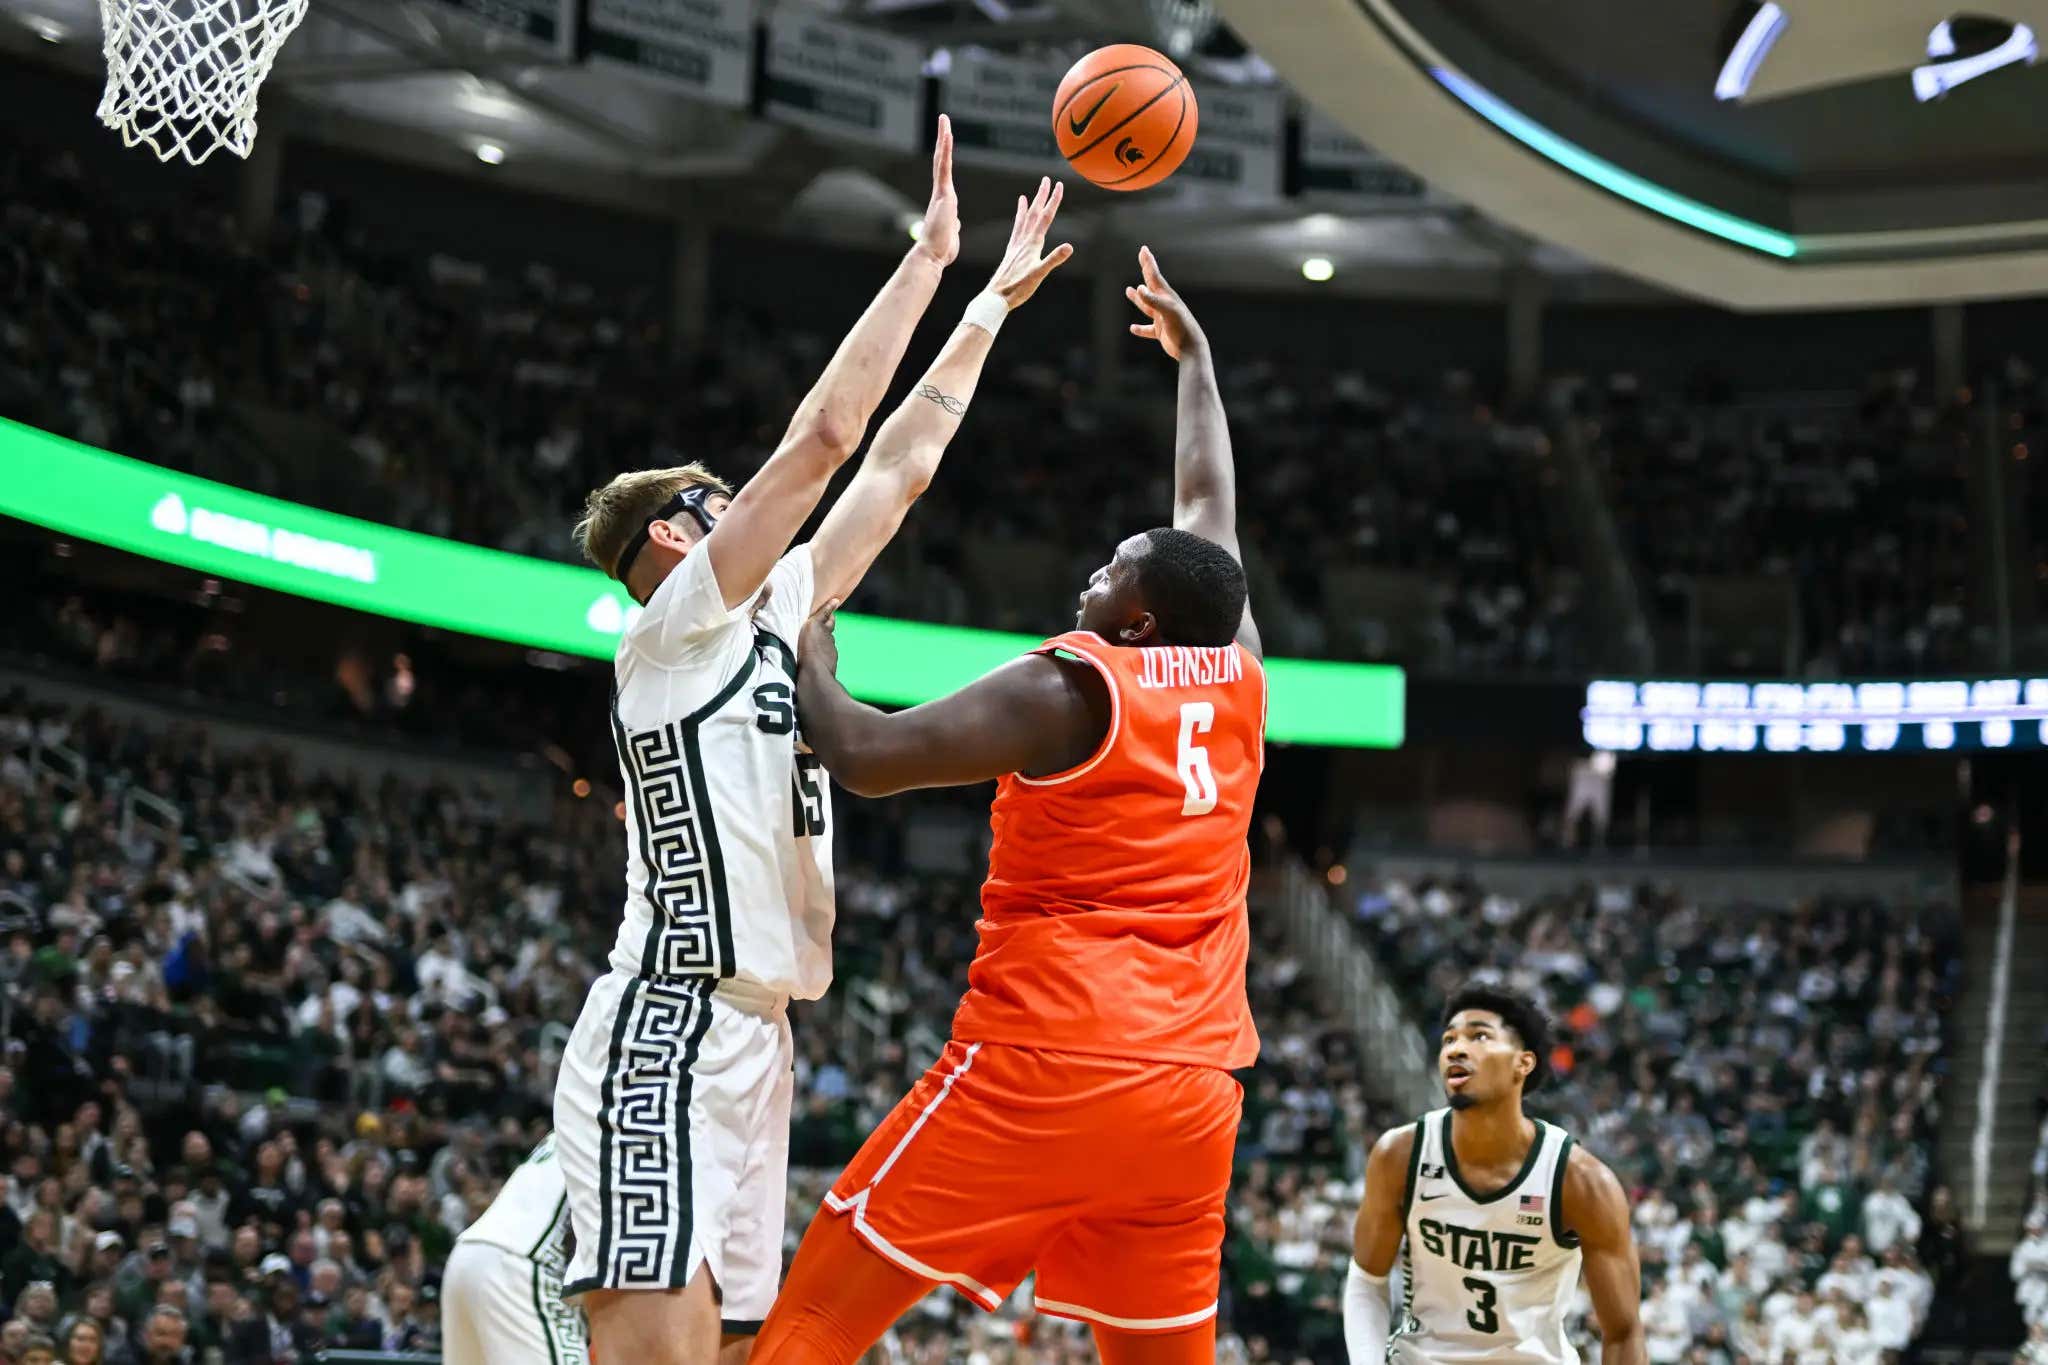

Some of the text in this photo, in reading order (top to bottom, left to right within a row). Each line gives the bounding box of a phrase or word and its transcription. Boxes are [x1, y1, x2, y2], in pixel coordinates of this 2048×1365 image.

[1137, 646, 1243, 688] JOHNSON
[1177, 702, 1218, 816] 6
[791, 754, 826, 838] 15
[1419, 1218, 1542, 1272] STATE
[1462, 1276, 1499, 1334] 3
